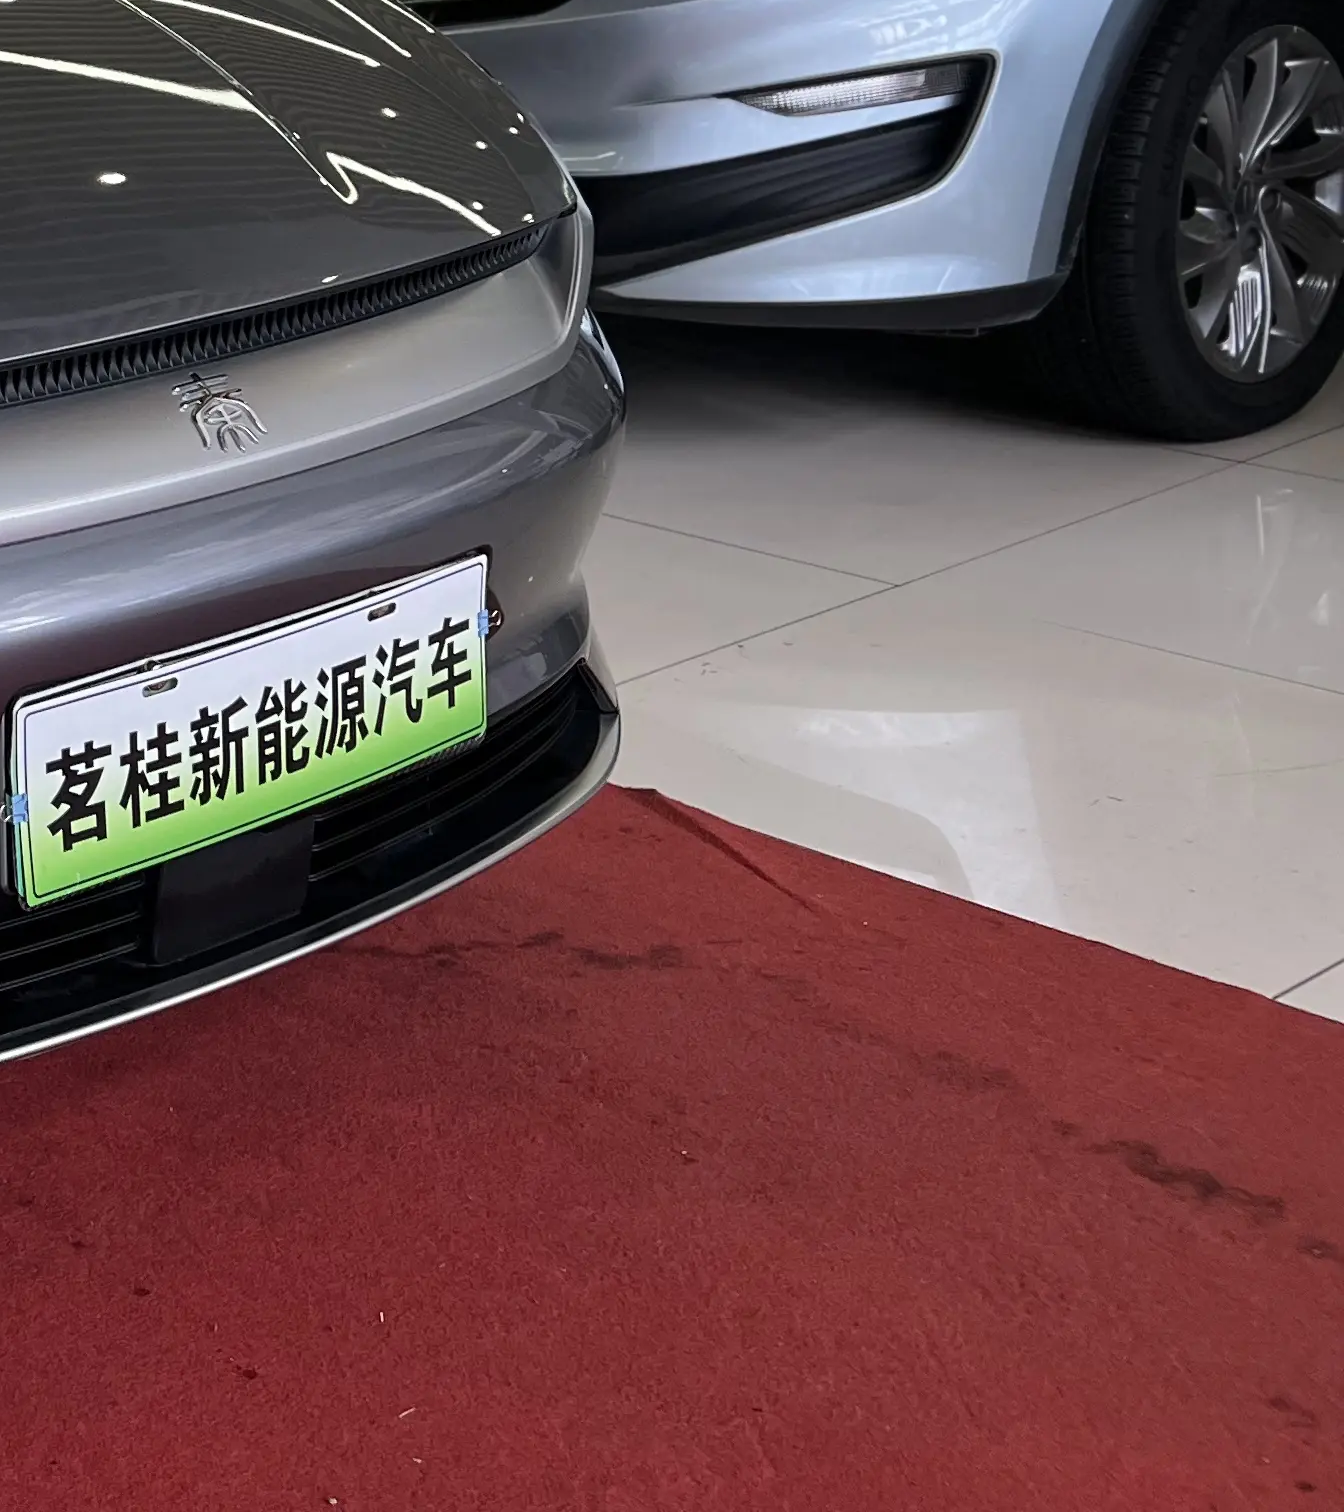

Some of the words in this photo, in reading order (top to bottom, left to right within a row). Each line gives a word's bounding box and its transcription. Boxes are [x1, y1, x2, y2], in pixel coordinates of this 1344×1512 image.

[44, 615, 474, 853] 茗桂新能源汽车
